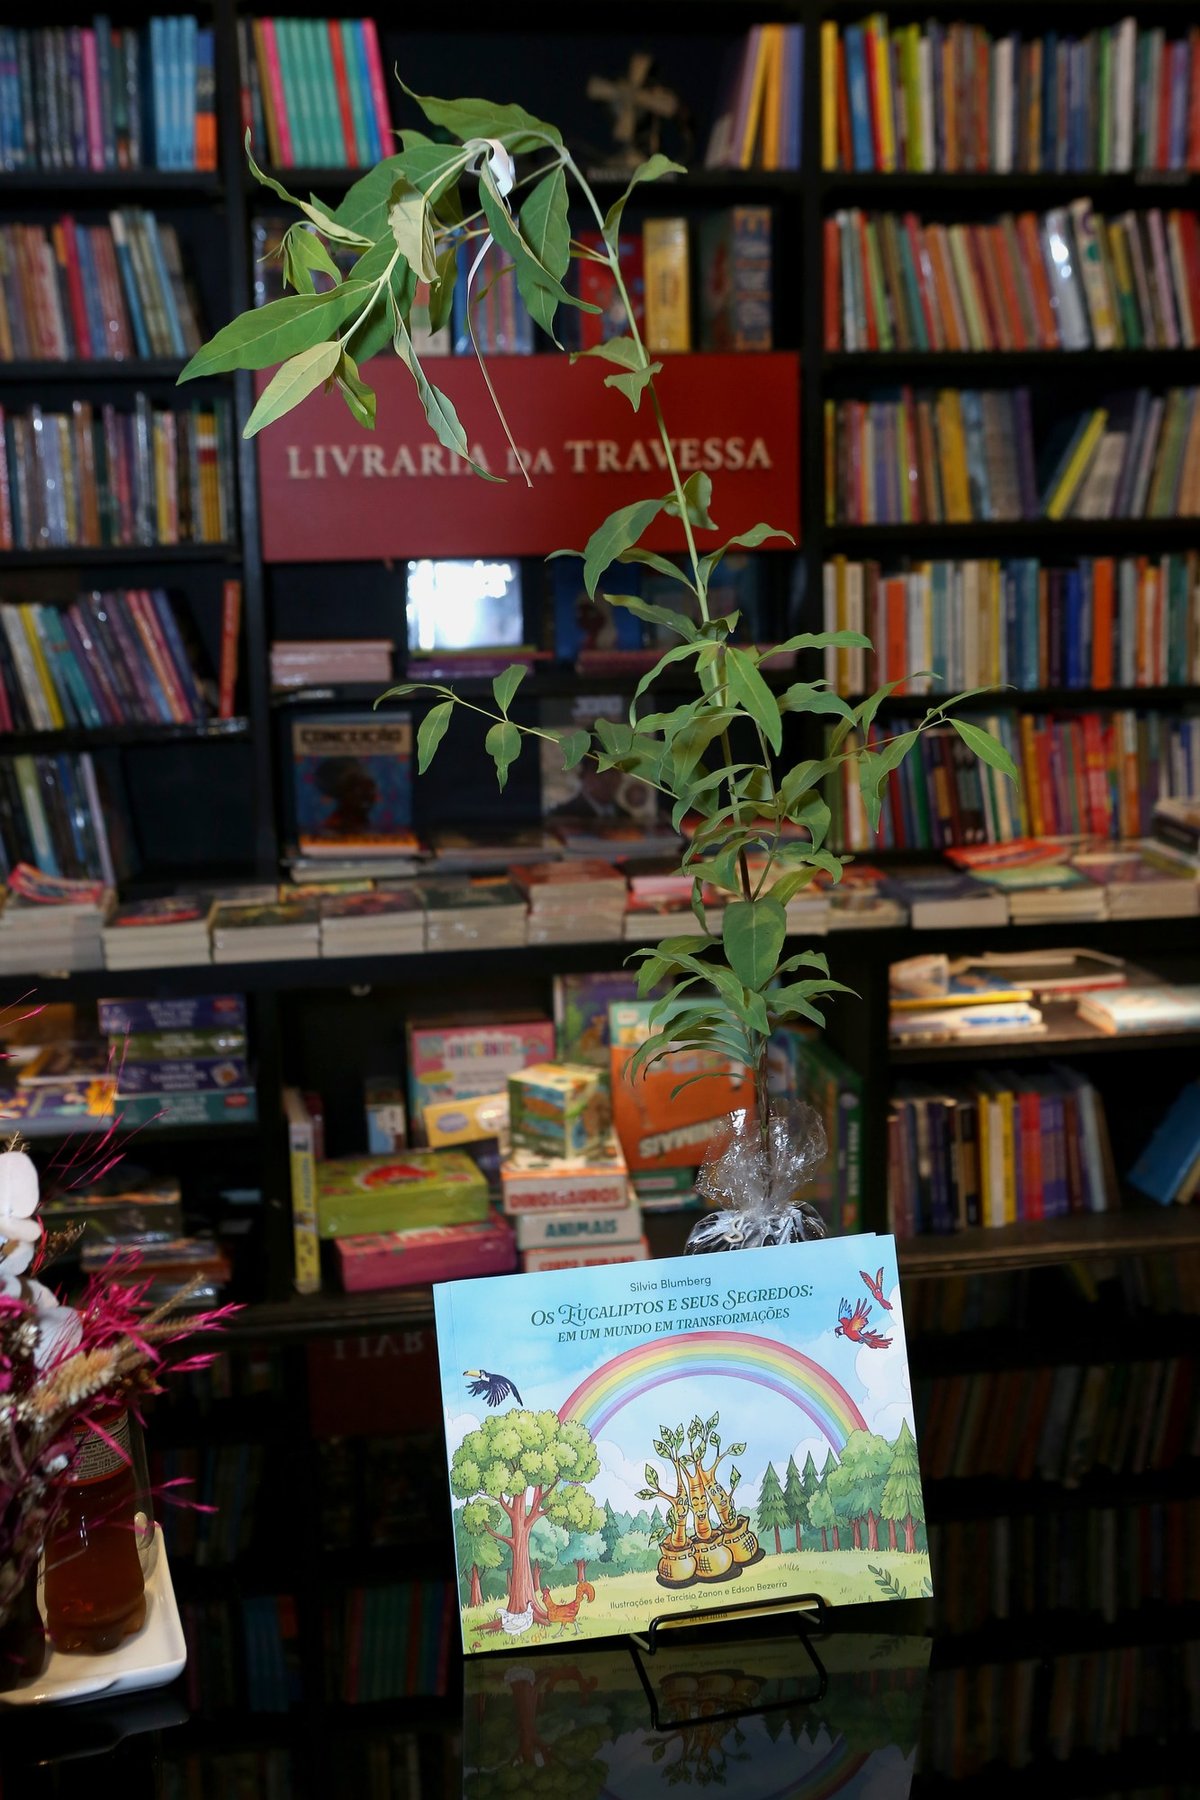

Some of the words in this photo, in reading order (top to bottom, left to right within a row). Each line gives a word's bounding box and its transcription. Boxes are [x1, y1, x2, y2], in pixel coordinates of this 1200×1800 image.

[287, 444, 491, 479] LIVRARIA
[506, 447, 555, 475] DA
[564, 437, 772, 474] TRAVESSA
[510, 1187, 620, 1209] DINOSAUROS
[545, 1219, 617, 1238] ANIMAIS
[630, 1281, 657, 1292] Silvia
[661, 1276, 711, 1289] Blumberg
[667, 1299, 678, 1312] E
[680, 1294, 719, 1310] SEUS
[722, 1284, 814, 1310] SEGREDOS:
[558, 1331, 577, 1343] EM
[580, 1328, 600, 1341] UM
[603, 1322, 652, 1338] MUNDO
[654, 1320, 674, 1333] EM
[676, 1306, 790, 1330] TRANSFORMAÇÕES
[610, 1599, 653, 1610] Ilustrações
[655, 1596, 665, 1604] de
[698, 1590, 722, 1599] Zanon
[732, 1586, 755, 1594] Edson
[757, 1581, 788, 1591] Bezerra
